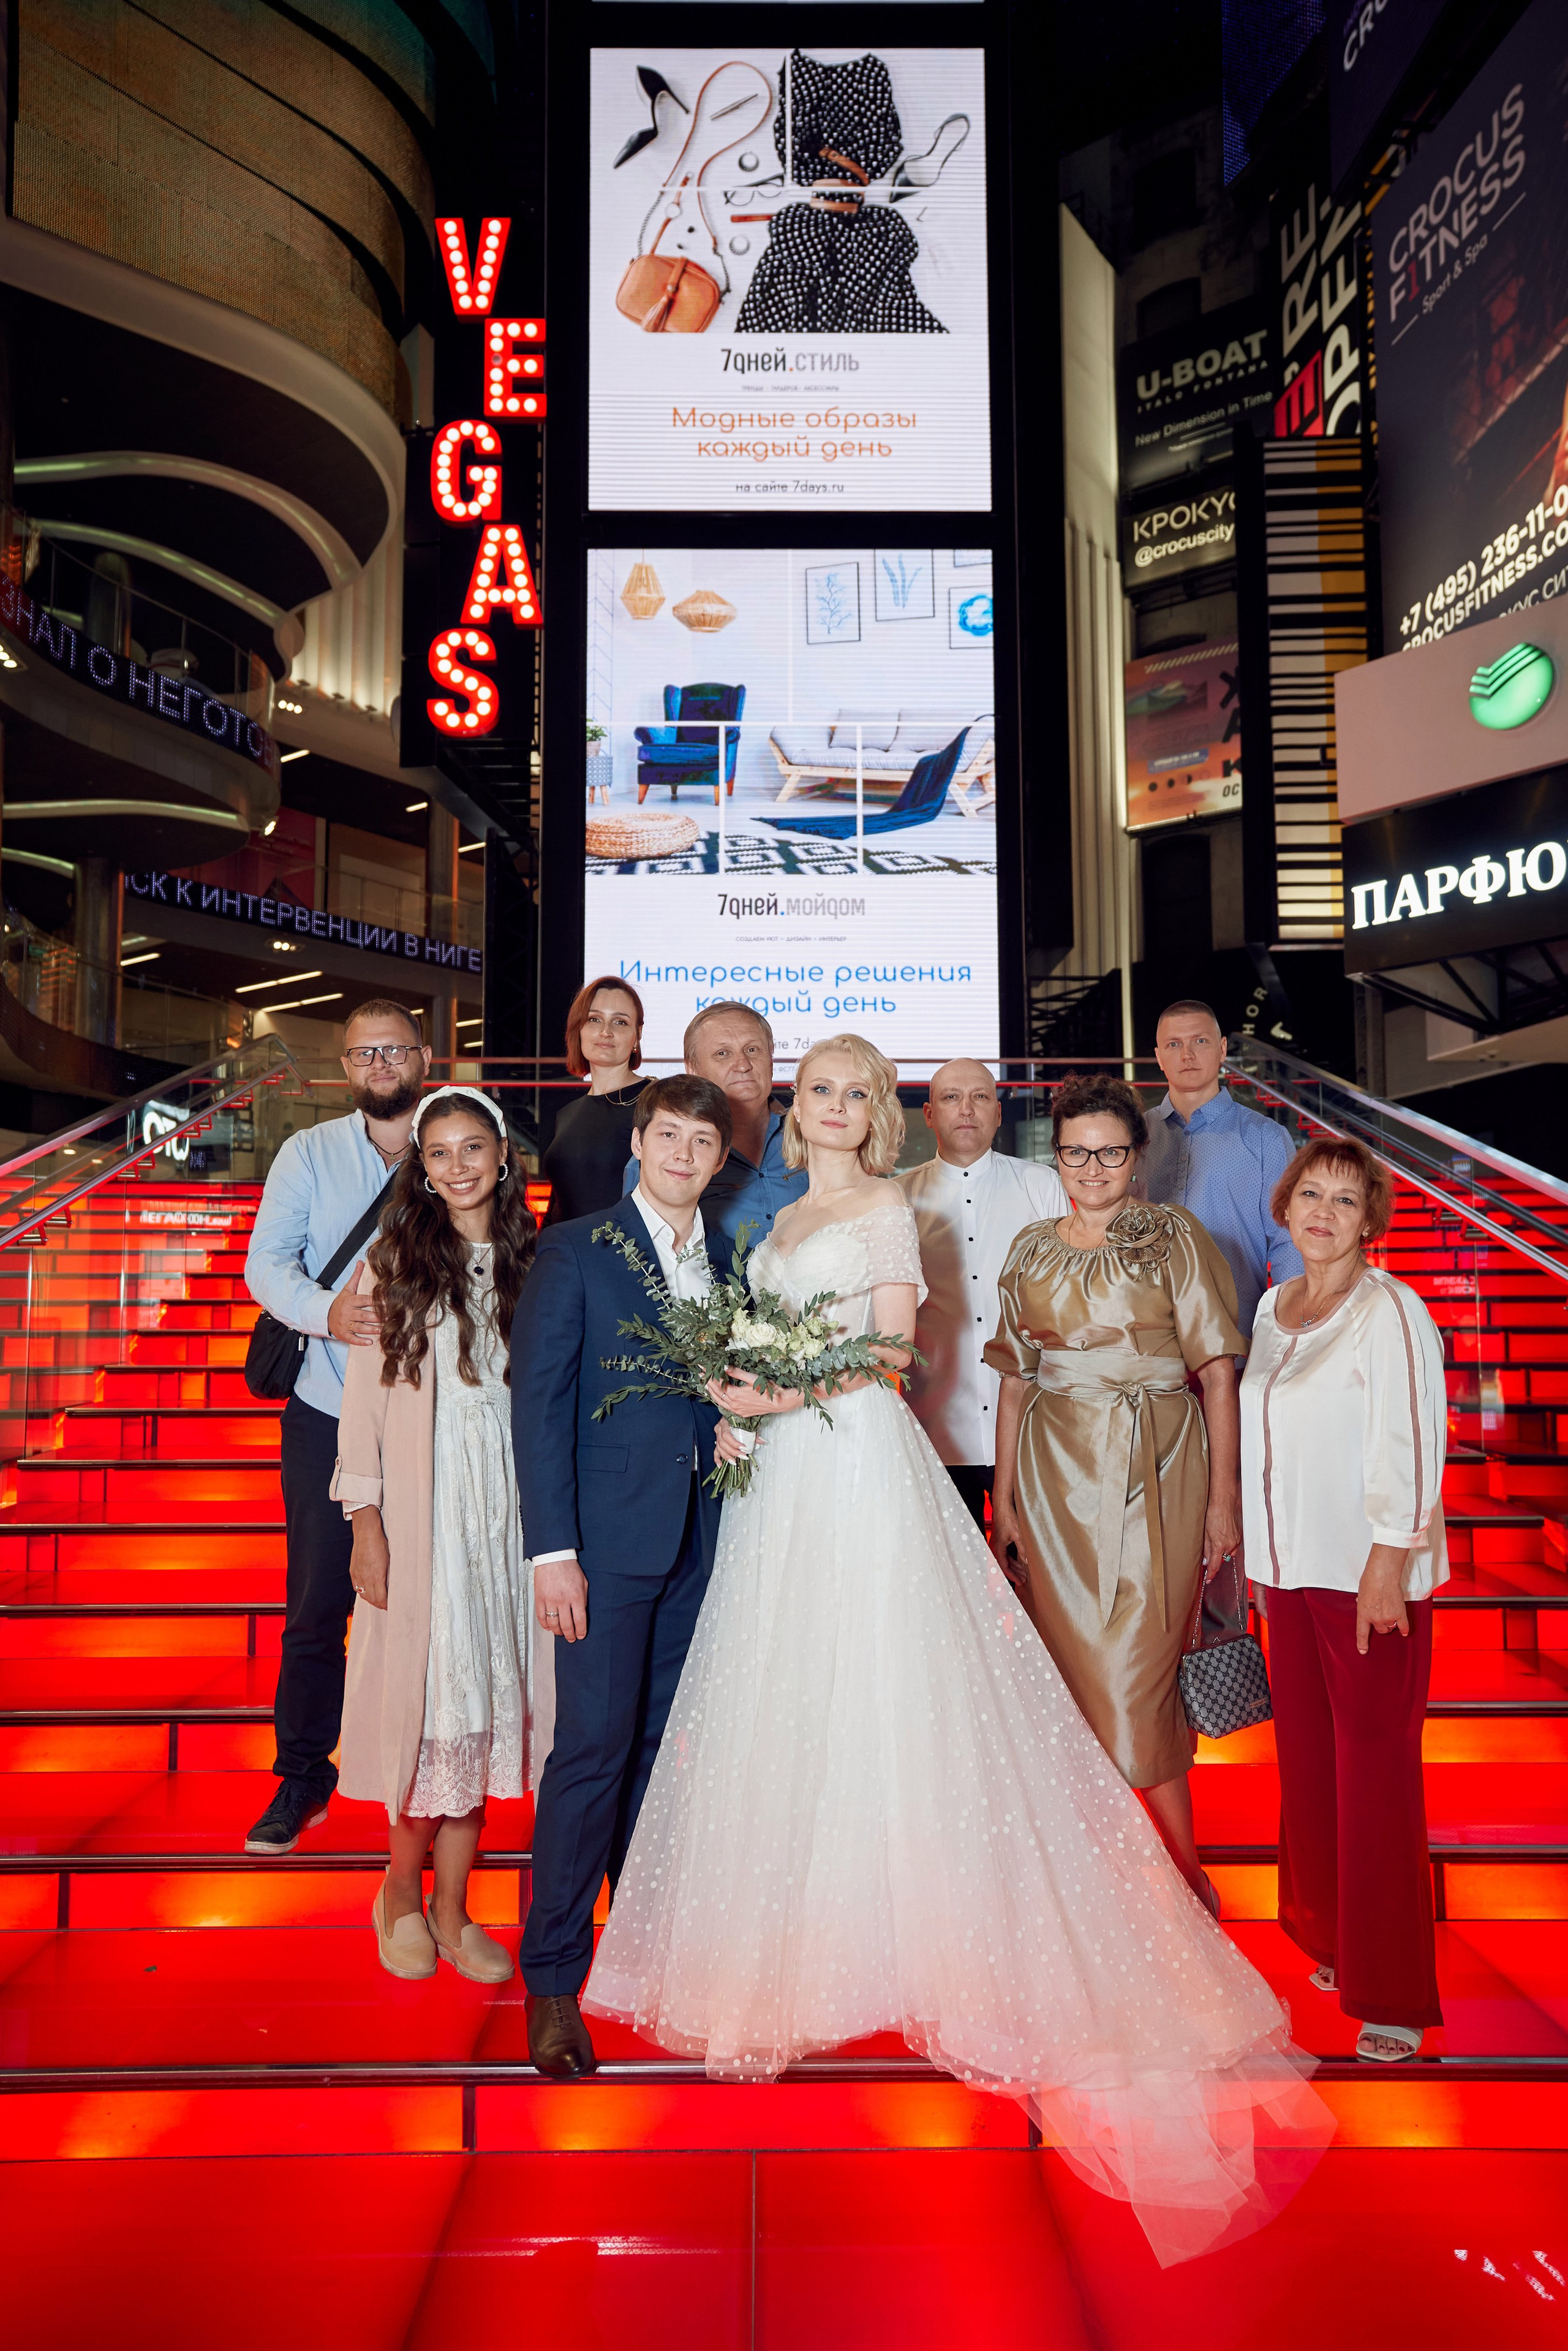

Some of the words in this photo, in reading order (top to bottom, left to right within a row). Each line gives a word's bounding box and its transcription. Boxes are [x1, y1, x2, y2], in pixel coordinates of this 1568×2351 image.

[1389, 83, 1525, 274] CROCUS
[1422, 270, 1453, 315] Sport
[1453, 257, 1463, 280] &
[1465, 233, 1489, 267] Spa
[1136, 330, 1267, 401] U-BOAT
[1137, 391, 1183, 414] ITALO
[1193, 360, 1268, 394] FONTANA
[673, 406, 795, 433] Модные
[805, 406, 917, 433] образы
[1135, 430, 1161, 447] New
[1163, 407, 1226, 438] Dimension
[1227, 402, 1240, 415] in
[1242, 390, 1273, 410] Time
[427, 217, 547, 738] VEGAS
[698, 436, 810, 462] каждый
[821, 442, 892, 462] день
[736, 482, 751, 493] на
[755, 481, 788, 493] сайте
[792, 480, 845, 494] 7days.ru
[1400, 601, 1422, 636] +7
[1425, 560, 1477, 622] (495)
[88, 644, 117, 687] О
[1351, 840, 1567, 930] ПАРФЮ
[176, 877, 194, 907] К
[202, 883, 398, 953] ИНТЕРВЕНЦИИ
[404, 932, 419, 957] В
[425, 938, 483, 973] НИГЕ
[620, 960, 824, 987] Интересные
[835, 965, 971, 987] решения
[696, 990, 811, 1017] кдый
[823, 996, 896, 1017] день
